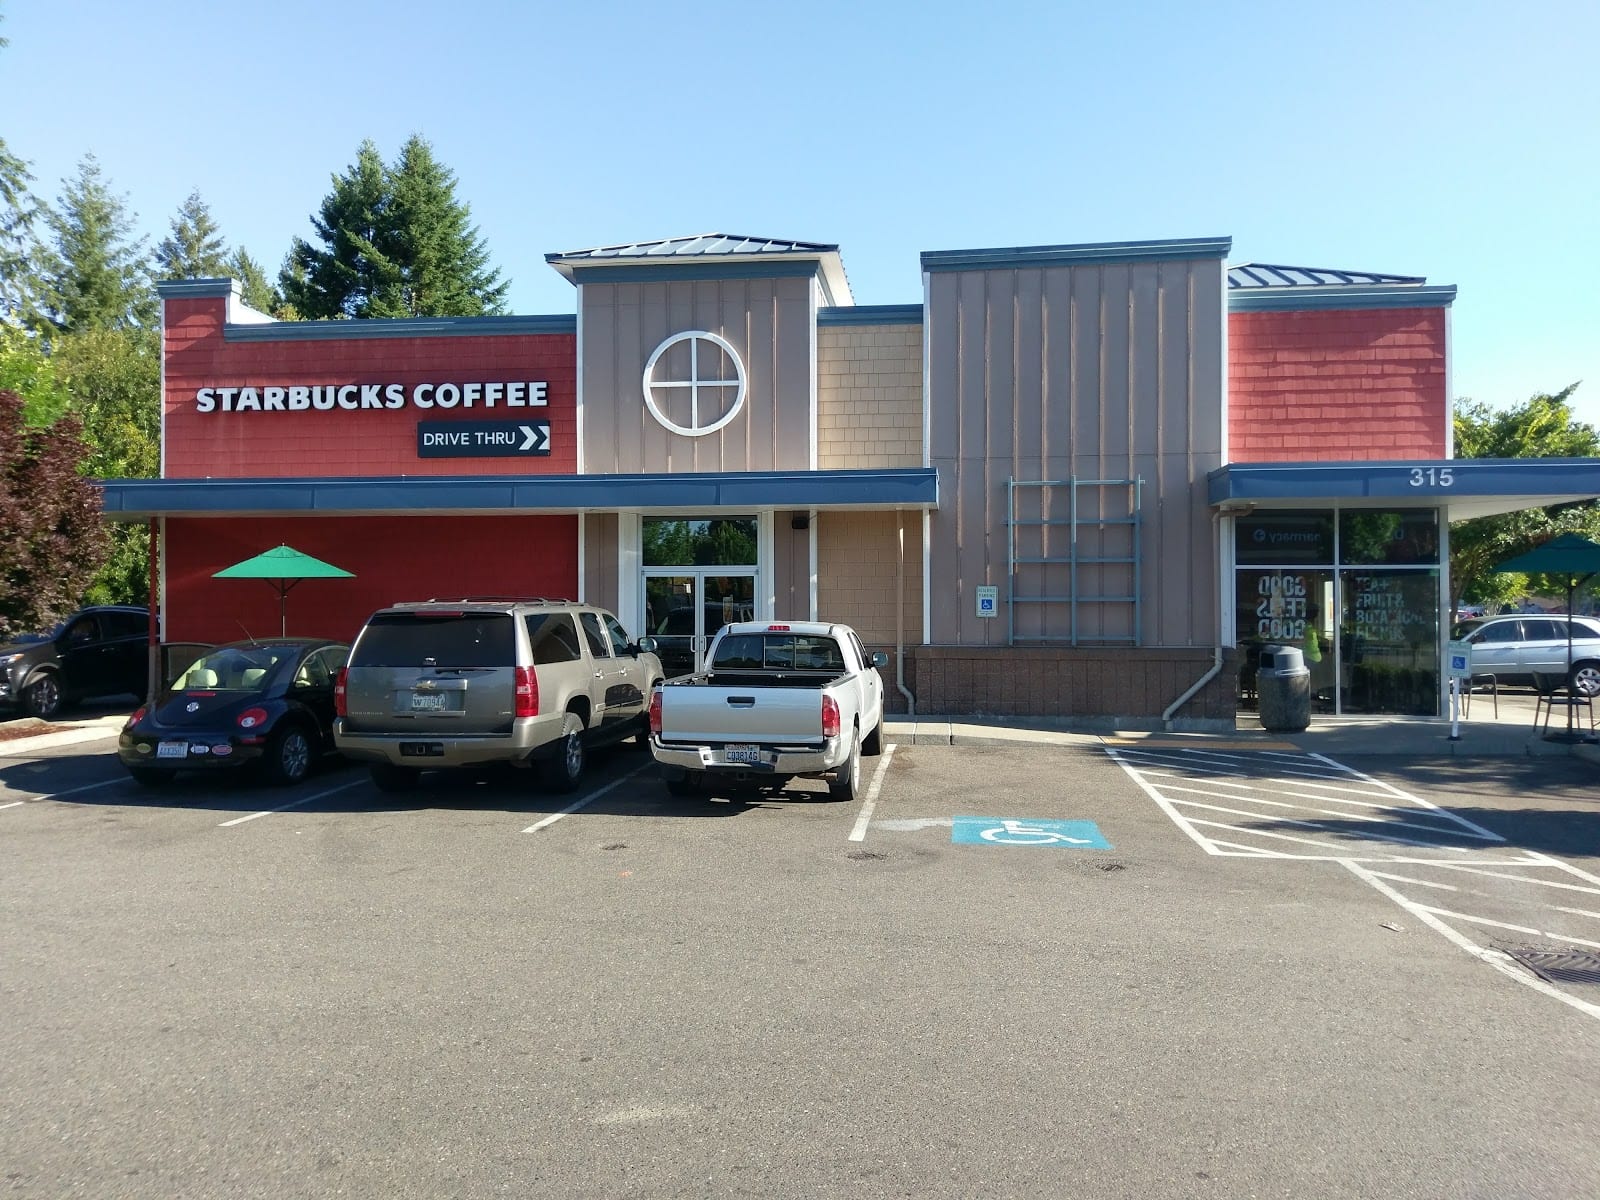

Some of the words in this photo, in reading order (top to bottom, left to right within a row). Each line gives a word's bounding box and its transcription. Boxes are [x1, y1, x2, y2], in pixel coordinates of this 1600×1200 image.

[196, 384, 405, 412] STARBUCKS
[413, 382, 548, 408] COFFEE
[423, 432, 469, 446] DRIVE
[474, 431, 516, 445] THRU
[1409, 469, 1454, 487] 315
